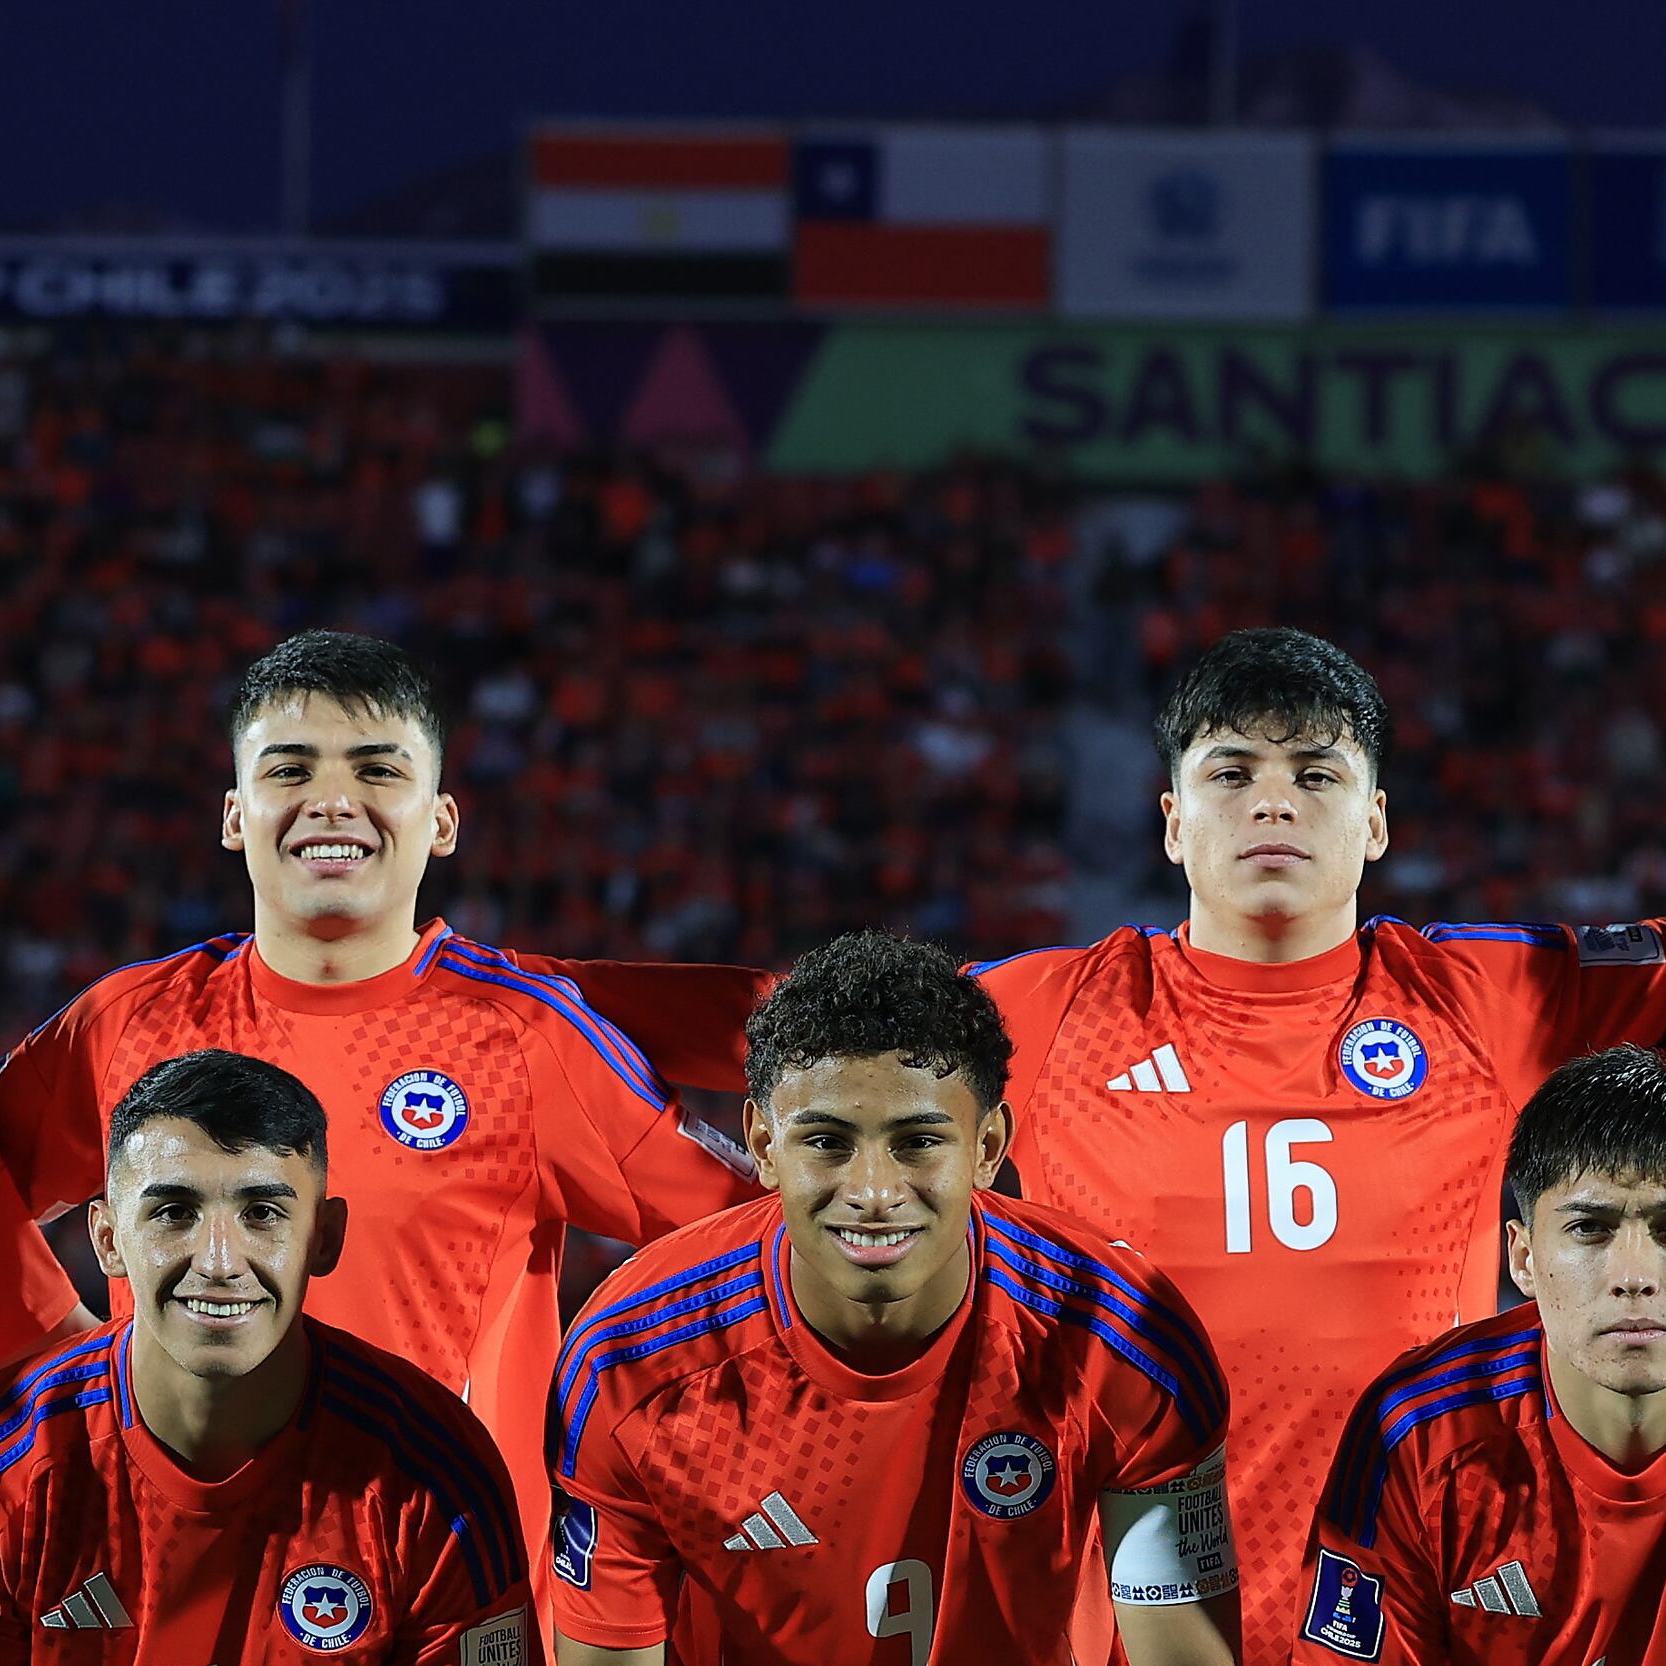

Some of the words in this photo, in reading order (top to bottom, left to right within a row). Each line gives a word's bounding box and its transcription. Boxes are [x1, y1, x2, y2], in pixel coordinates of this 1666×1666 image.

[1355, 192, 1539, 268] FIFA
[1343, 1022, 1374, 1065] FEDERACION
[1380, 1021, 1393, 1032] DE
[382, 1073, 428, 1107] FEDERACION
[432, 1074, 445, 1086] DE
[1373, 1087, 1385, 1097] DE
[1389, 1085, 1414, 1098] CHILE
[399, 1133, 411, 1144] DE
[416, 1136, 443, 1149] CHILE
[1221, 1118, 1339, 1254] 16
[282, 1566, 325, 1604] FEDERACION
[332, 1568, 344, 1579] DE
[301, 1634, 315, 1646] DE
[321, 1634, 349, 1649] CHILE
[479, 1626, 521, 1647] FOOTBALL
[478, 1639, 521, 1664] UNITES
